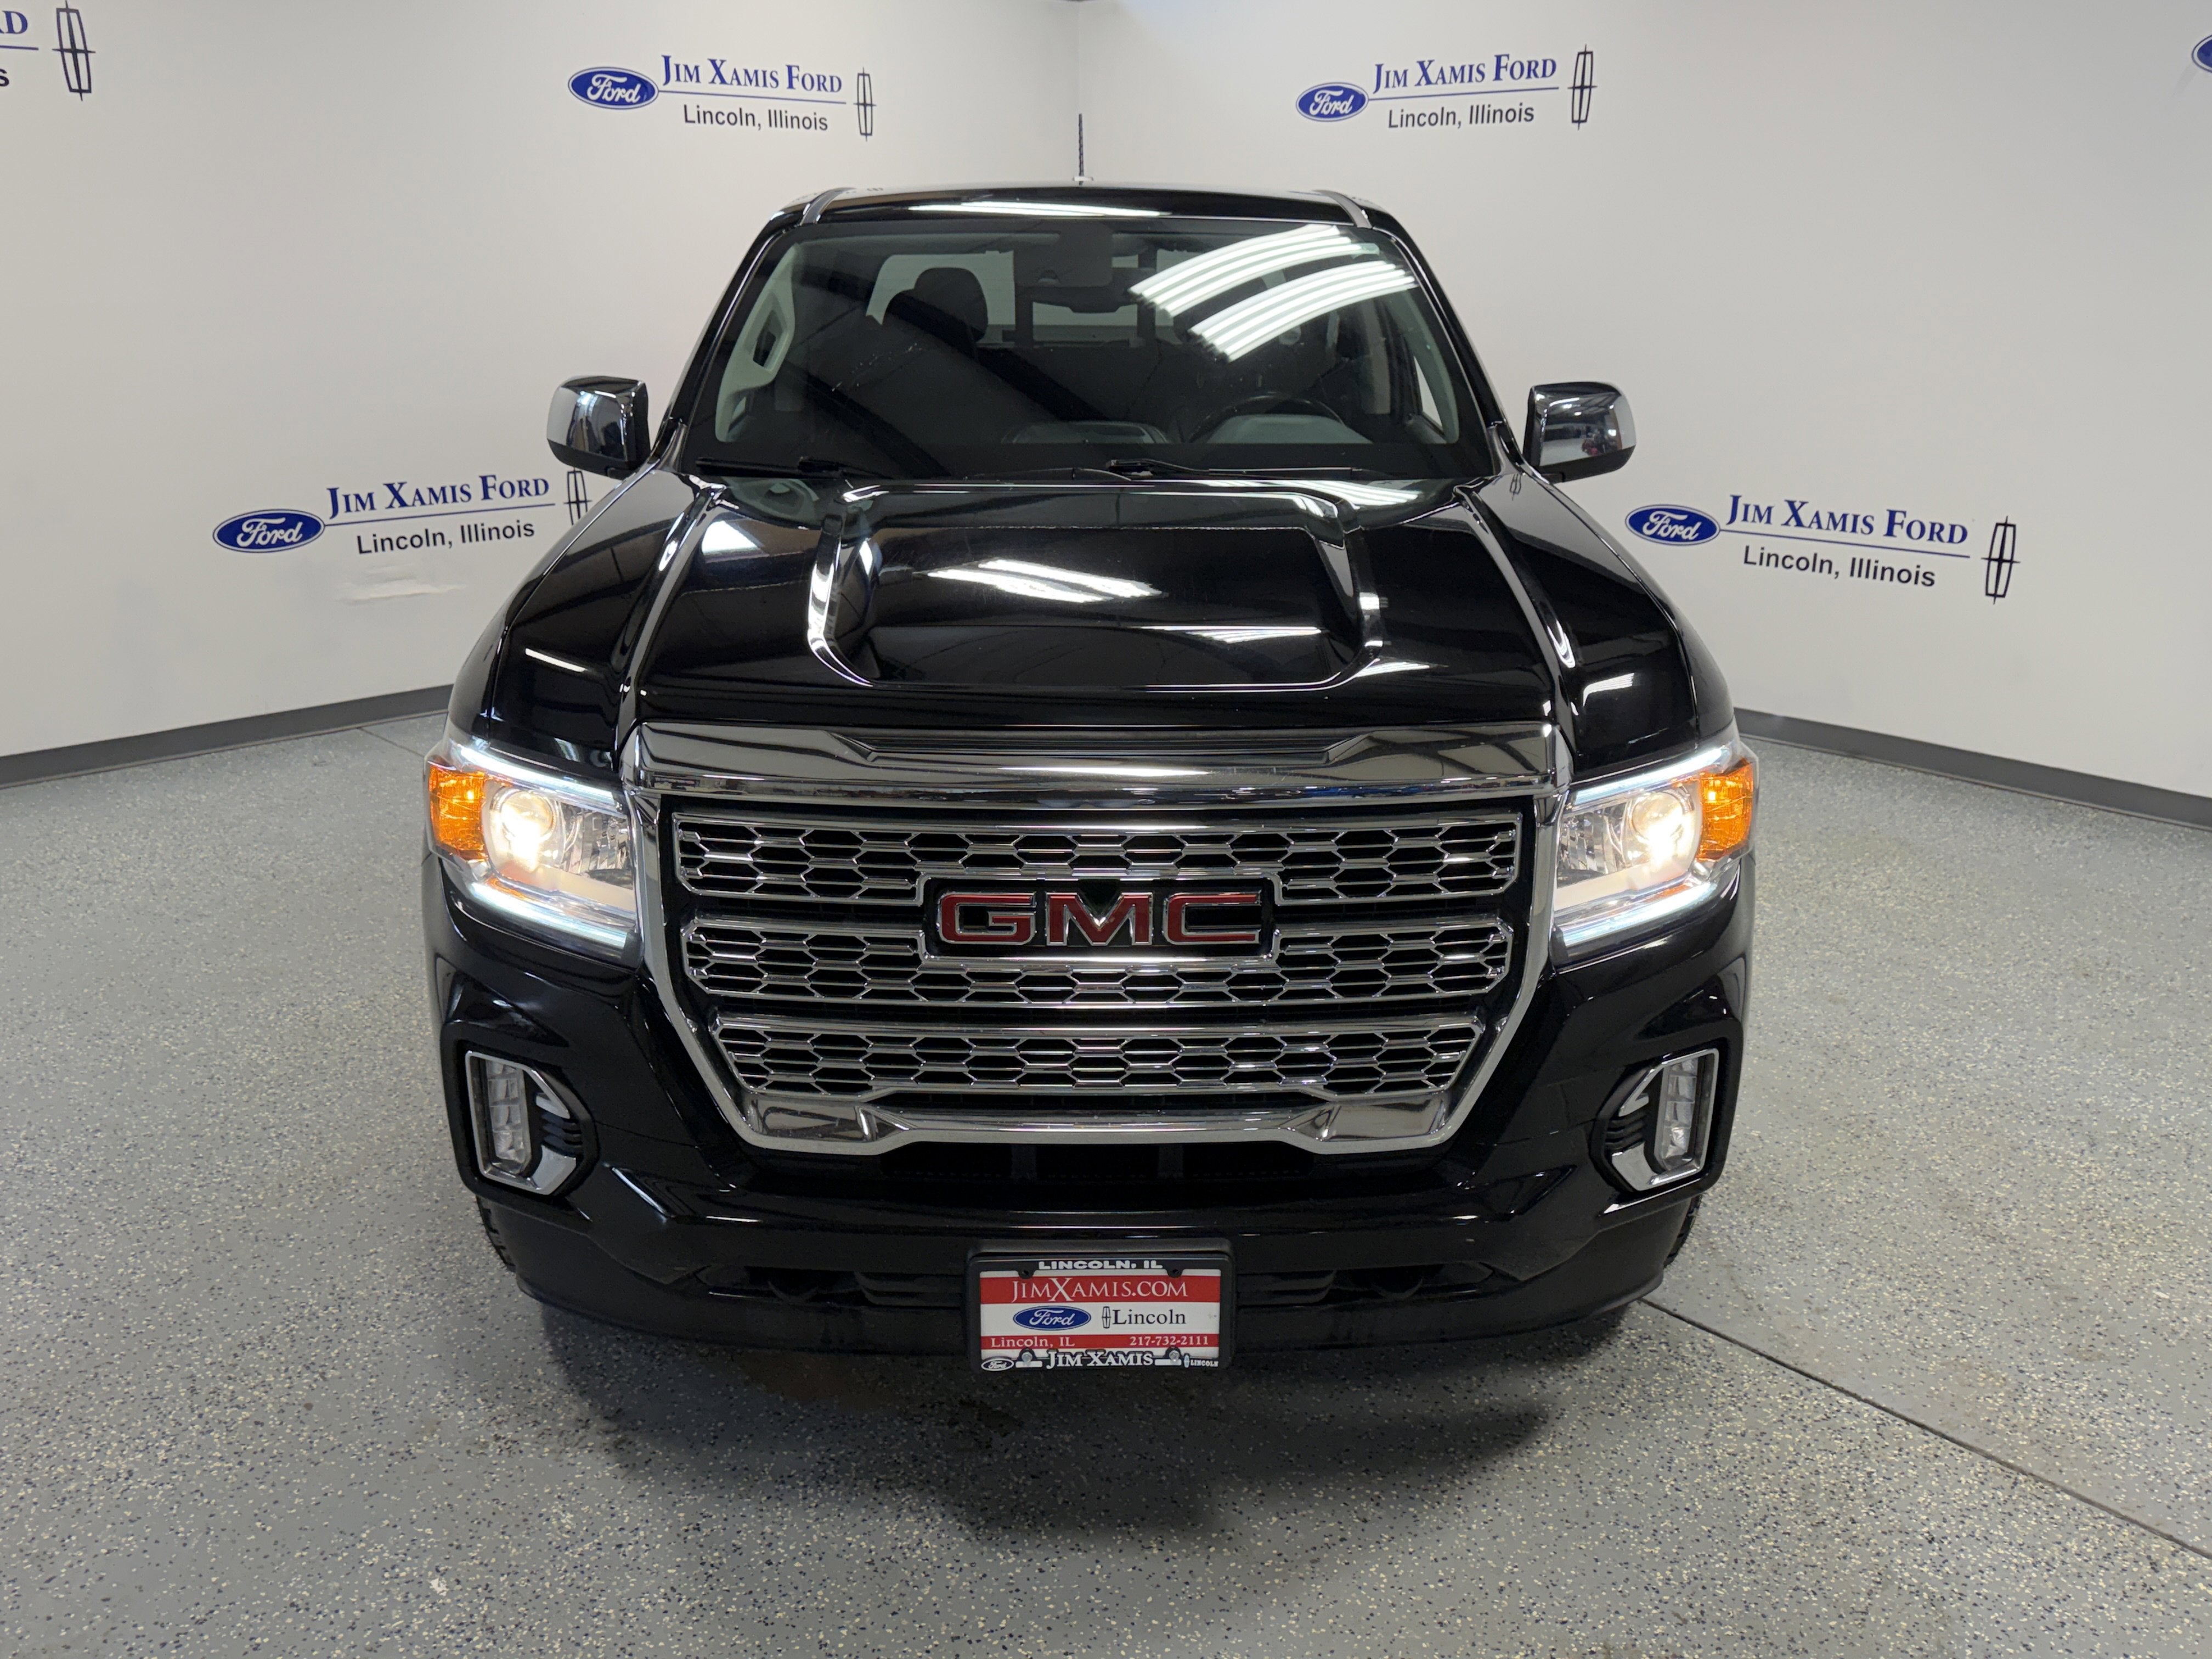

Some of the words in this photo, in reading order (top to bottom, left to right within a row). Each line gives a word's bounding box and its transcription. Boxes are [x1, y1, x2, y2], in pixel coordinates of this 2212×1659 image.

[661, 55, 701, 86] JIM
[707, 58, 780, 89] XAMIS
[785, 64, 843, 93] FORD
[1373, 63, 1409, 94] JIM
[1414, 59, 1486, 87] XAMIS
[1493, 53, 1558, 81] FORD
[586, 73, 641, 104] Ford
[1308, 89, 1353, 115] Ford
[684, 104, 761, 130] Lincoln,
[768, 109, 828, 131] Illinois
[1388, 106, 1462, 129] Lincoln,
[1469, 102, 1534, 126] Illinois
[326, 487, 375, 519] JIM
[383, 481, 472, 509] XAMIS
[479, 475, 550, 501] FORD
[236, 517, 303, 548] Ford
[1641, 511, 1702, 540] Ford
[1726, 494, 1775, 526] JIM
[1781, 500, 1875, 536] XAMIS
[1883, 509, 1968, 545] FORD
[356, 526, 453, 555] Lincoln,
[460, 520, 535, 545] Illinois
[1743, 545, 1840, 580] Lincoln,
[1849, 557, 1937, 587] Illinois
[936, 891, 1262, 945] GMC
[1143, 1260, 1163, 1269] IL
[1029, 1308, 1074, 1327] Ford
[1112, 1309, 1186, 1325] Lincoln
[991, 1336, 1053, 1348] Lincoln,
[1059, 1336, 1075, 1347] IL
[1129, 1336, 1209, 1346] 217-732-2111
[1046, 1351, 1083, 1369] JIM
[1087, 1351, 1153, 1367] XAMIS
